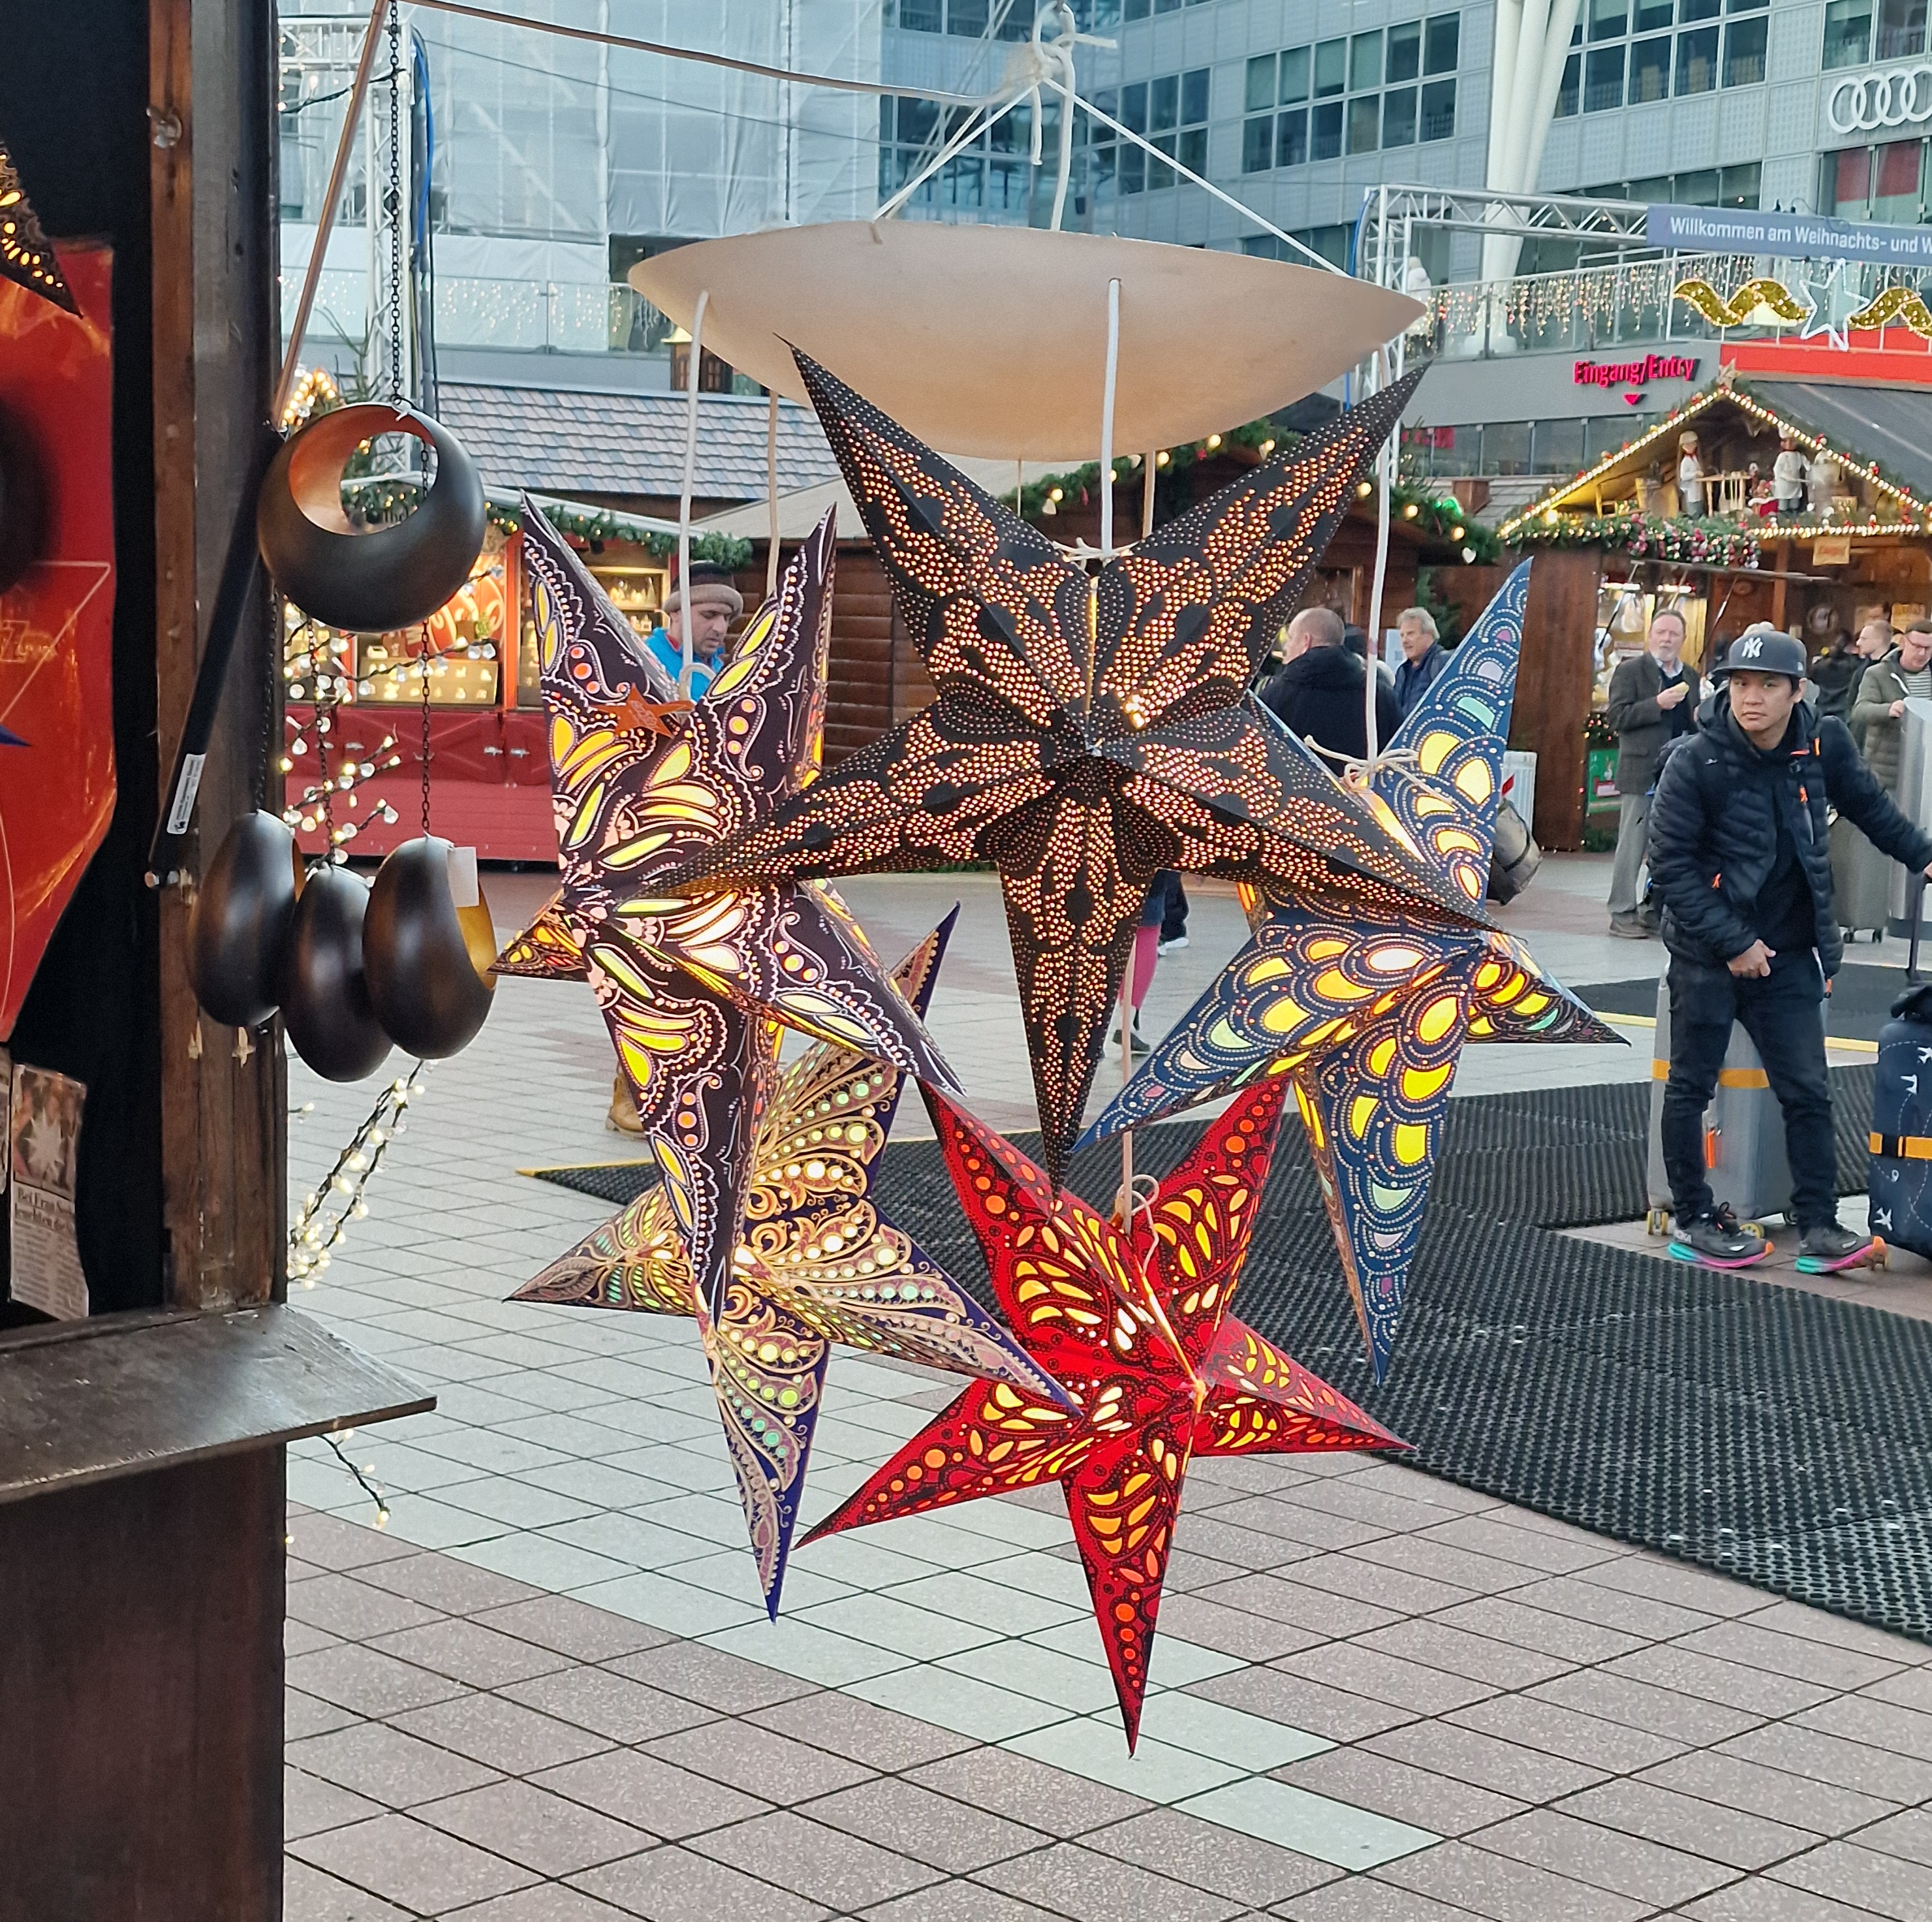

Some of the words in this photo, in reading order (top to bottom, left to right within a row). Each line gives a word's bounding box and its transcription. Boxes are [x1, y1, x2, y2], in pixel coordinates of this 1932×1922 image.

[1670, 216, 1764, 240] Willkommen
[1768, 227, 1791, 243] am
[1795, 226, 1887, 250] Weihnachts-
[1891, 236, 1918, 253] und
[1574, 353, 1696, 388] Eingang/Entry
[1741, 637, 1764, 659] NY
